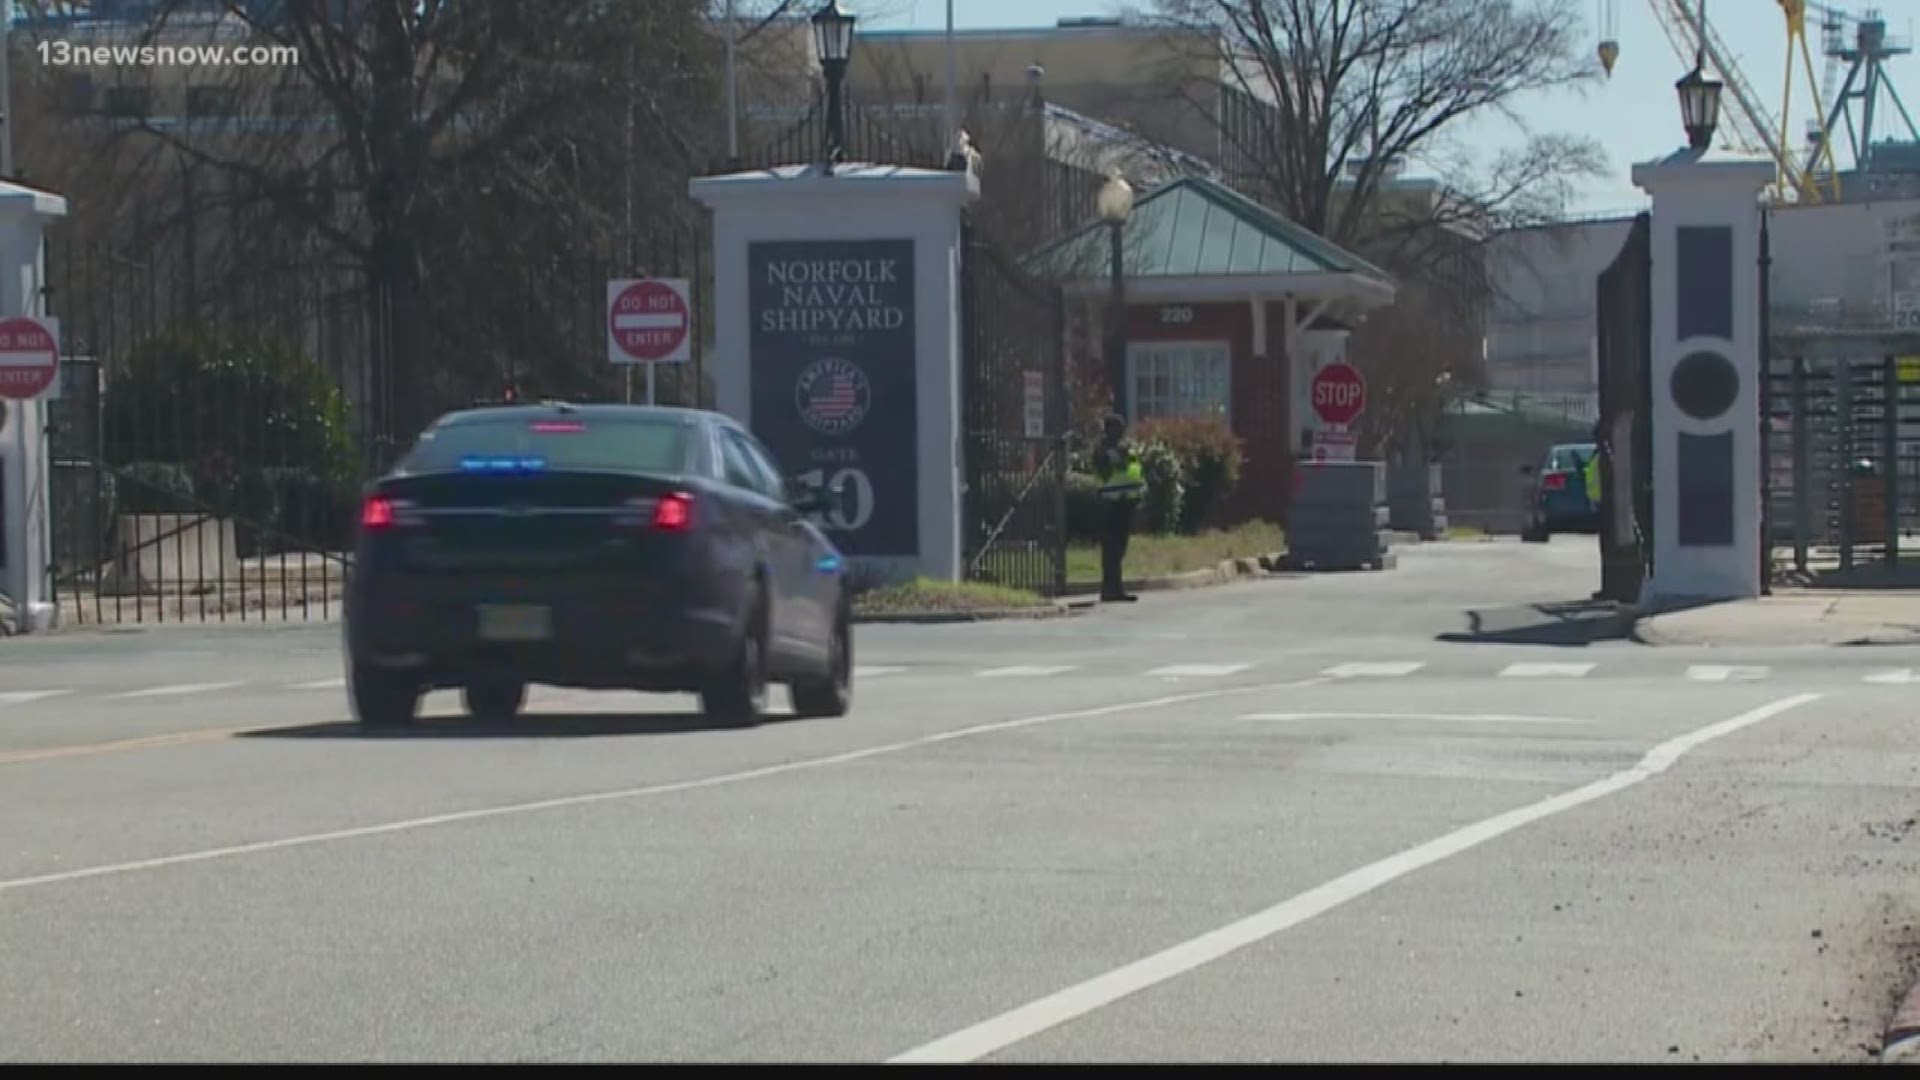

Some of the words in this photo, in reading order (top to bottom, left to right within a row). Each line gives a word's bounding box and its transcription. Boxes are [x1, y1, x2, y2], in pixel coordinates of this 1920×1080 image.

[767, 258, 897, 284] NORFOLK
[622, 296, 641, 311] DO
[648, 294, 676, 310] NOT
[783, 284, 882, 306] NAVAL
[761, 308, 903, 331] SHIPYARD
[1160, 307, 1192, 323] 220
[17, 332, 45, 348] NOT
[626, 331, 673, 346] ENTER
[1315, 382, 1361, 406] STOP
[810, 448, 860, 461] GATE
